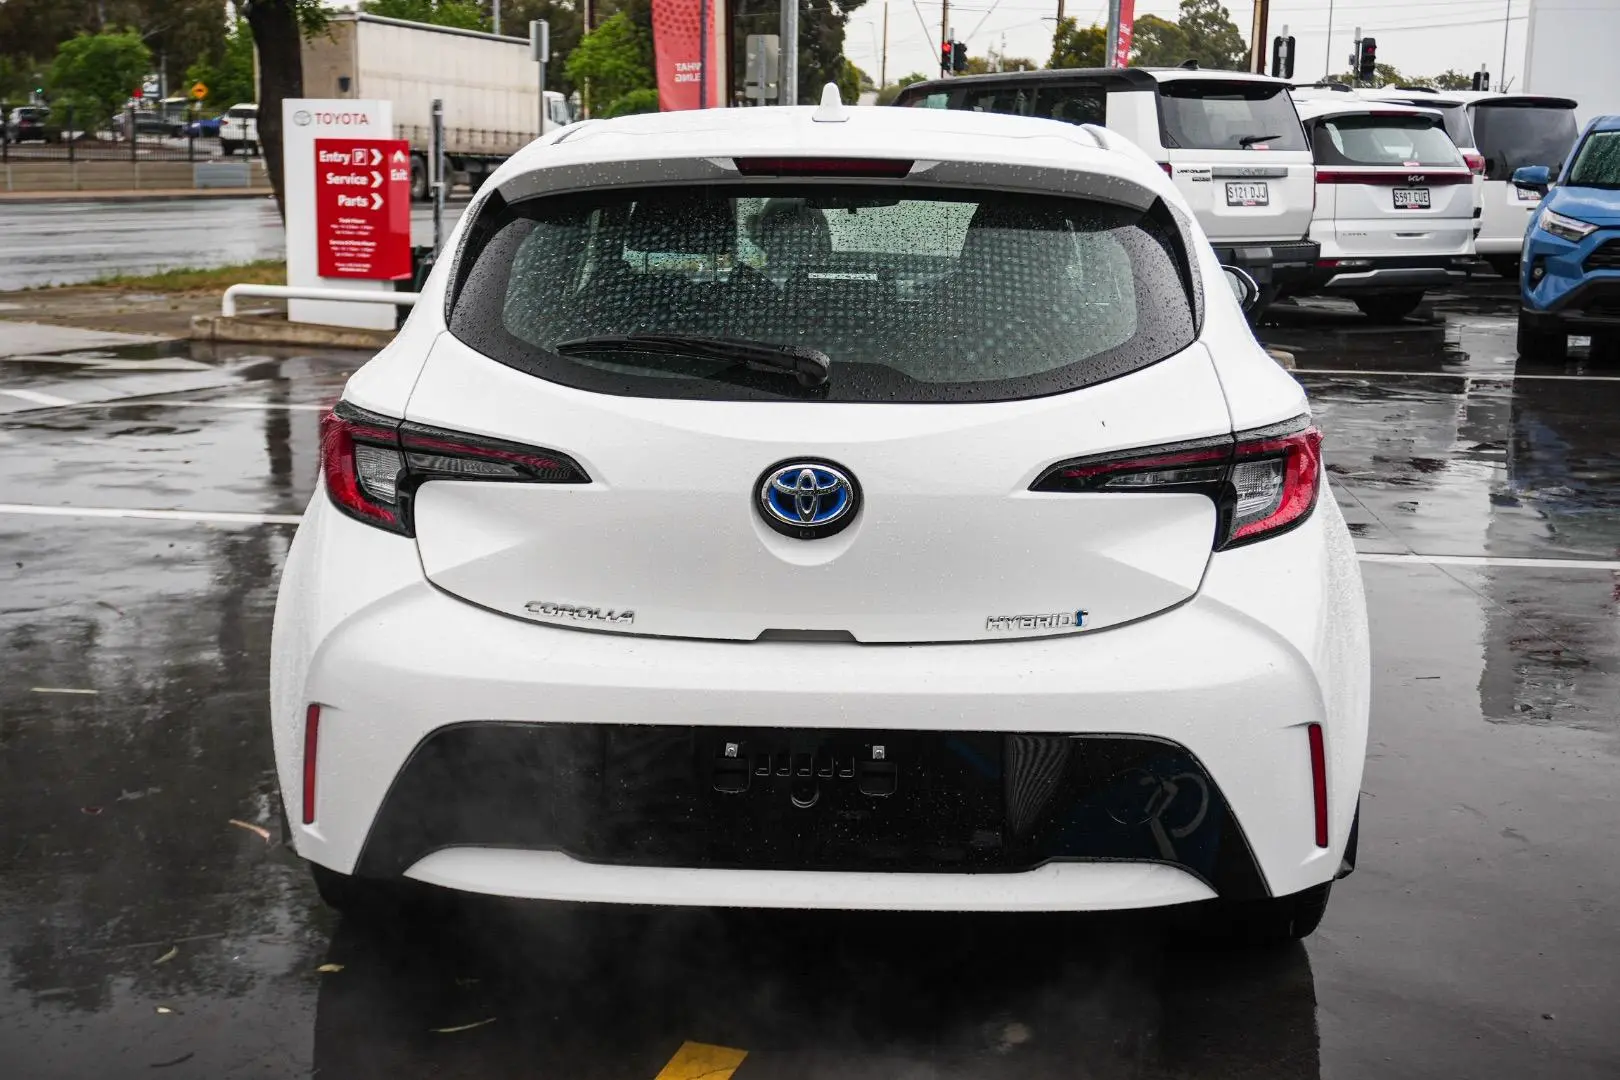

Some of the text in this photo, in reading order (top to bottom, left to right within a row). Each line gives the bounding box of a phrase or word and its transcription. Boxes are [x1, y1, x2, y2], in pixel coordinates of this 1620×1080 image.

[315, 112, 369, 125] TOYOTA
[319, 150, 351, 165] Entry
[326, 172, 369, 185] Service
[390, 169, 408, 181] Exit
[1228, 186, 1266, 198] S121 DJJ
[337, 194, 369, 207] Parts
[524, 600, 634, 624] COROLLA
[986, 611, 1076, 631] HYBRID
